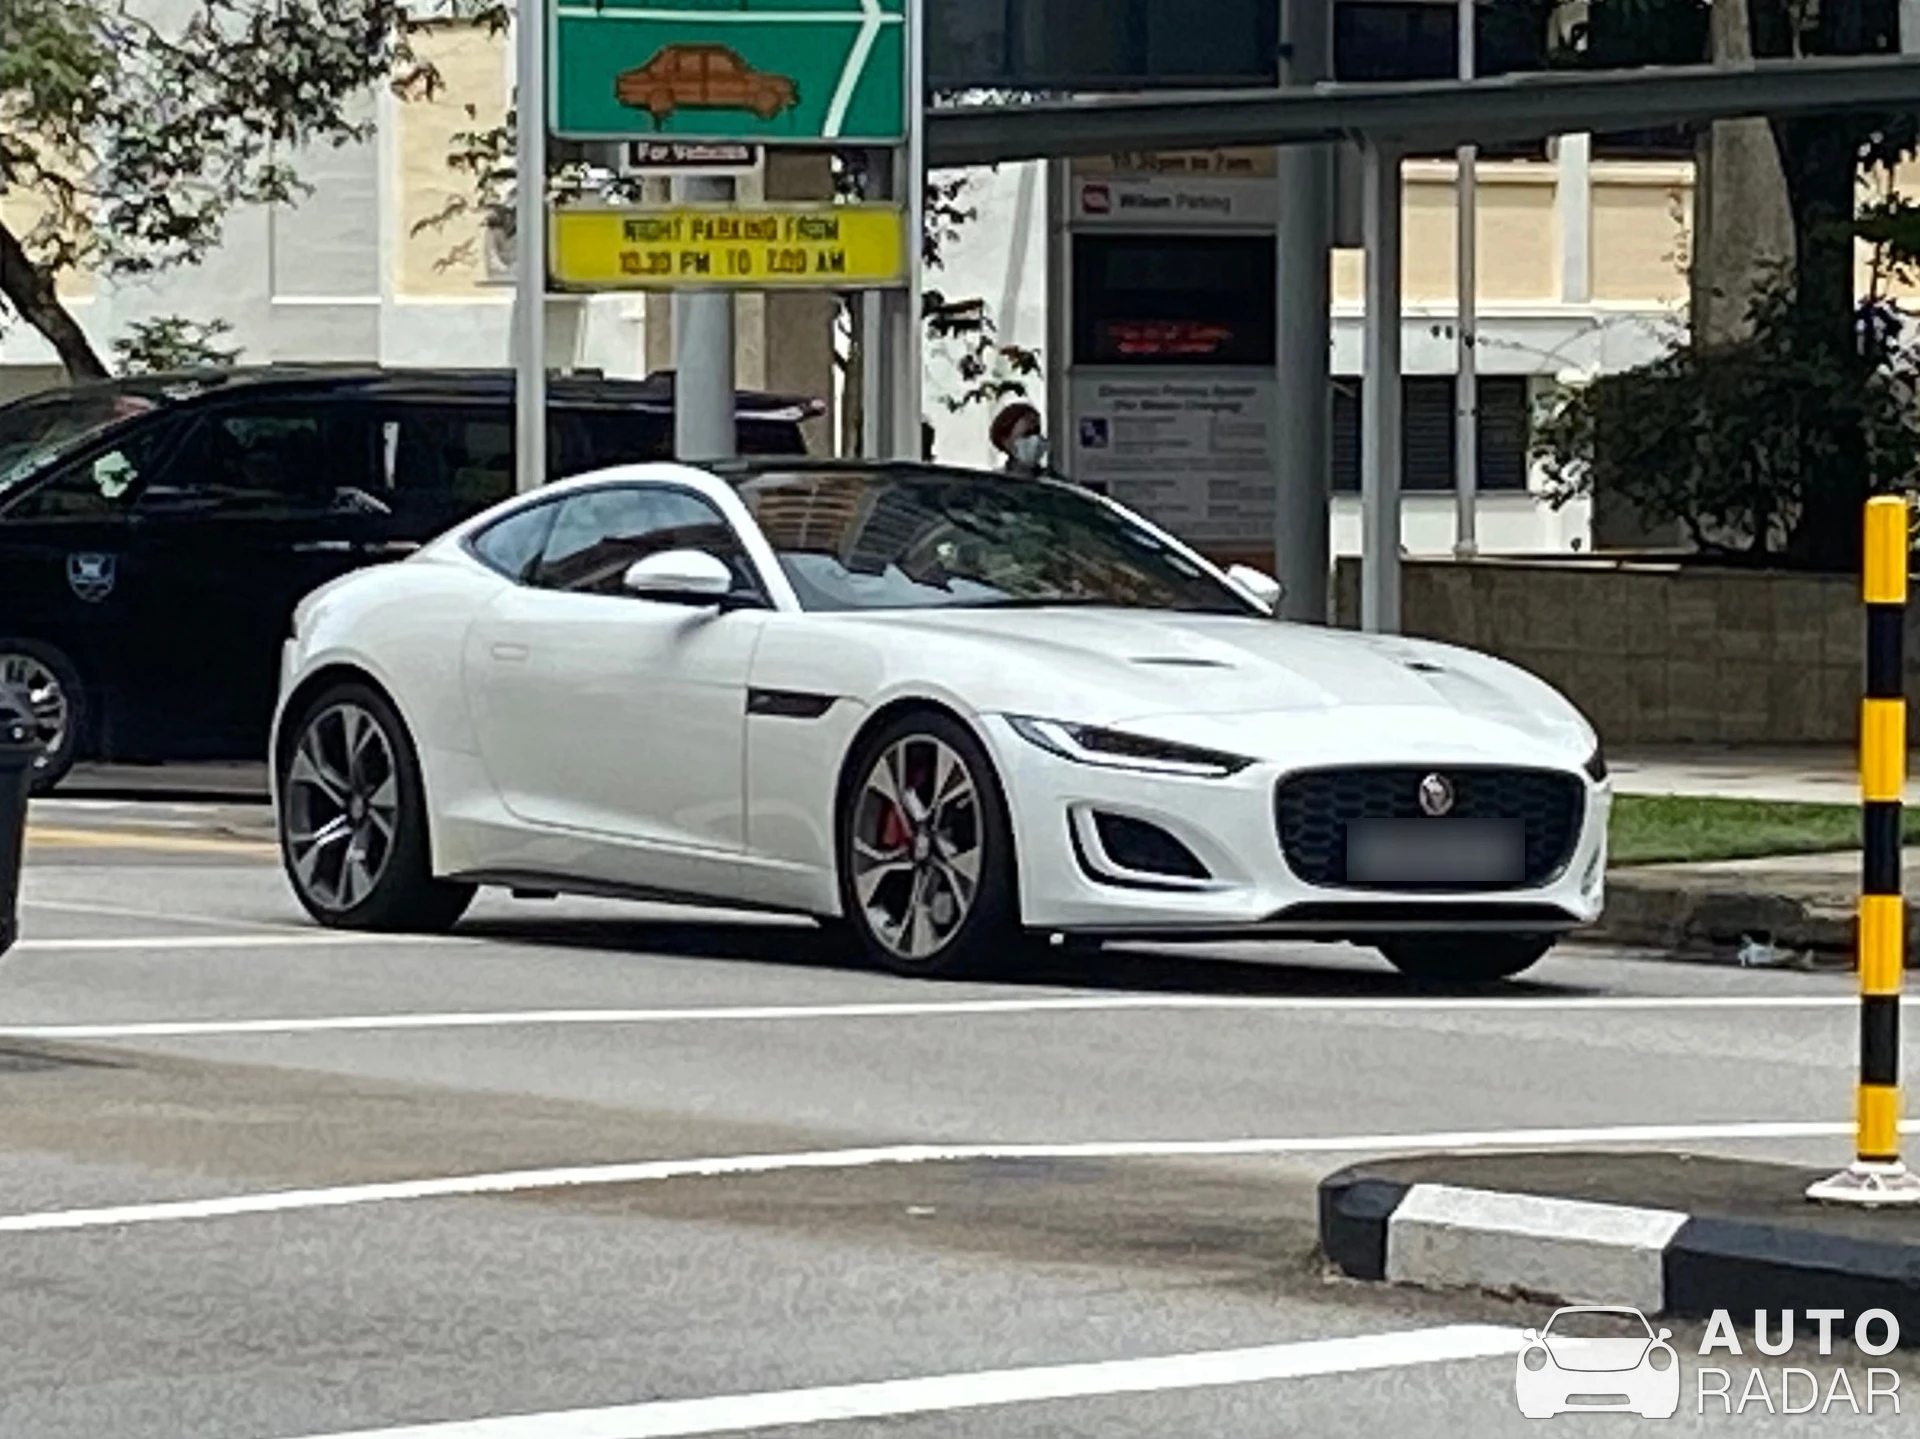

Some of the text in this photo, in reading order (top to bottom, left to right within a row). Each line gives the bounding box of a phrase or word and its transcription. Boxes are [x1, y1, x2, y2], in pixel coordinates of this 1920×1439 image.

[691, 218, 777, 240] PARKING
[785, 218, 839, 240] FROM
[680, 249, 710, 273] PM
[725, 248, 751, 272] TO
[816, 248, 845, 273] AM
